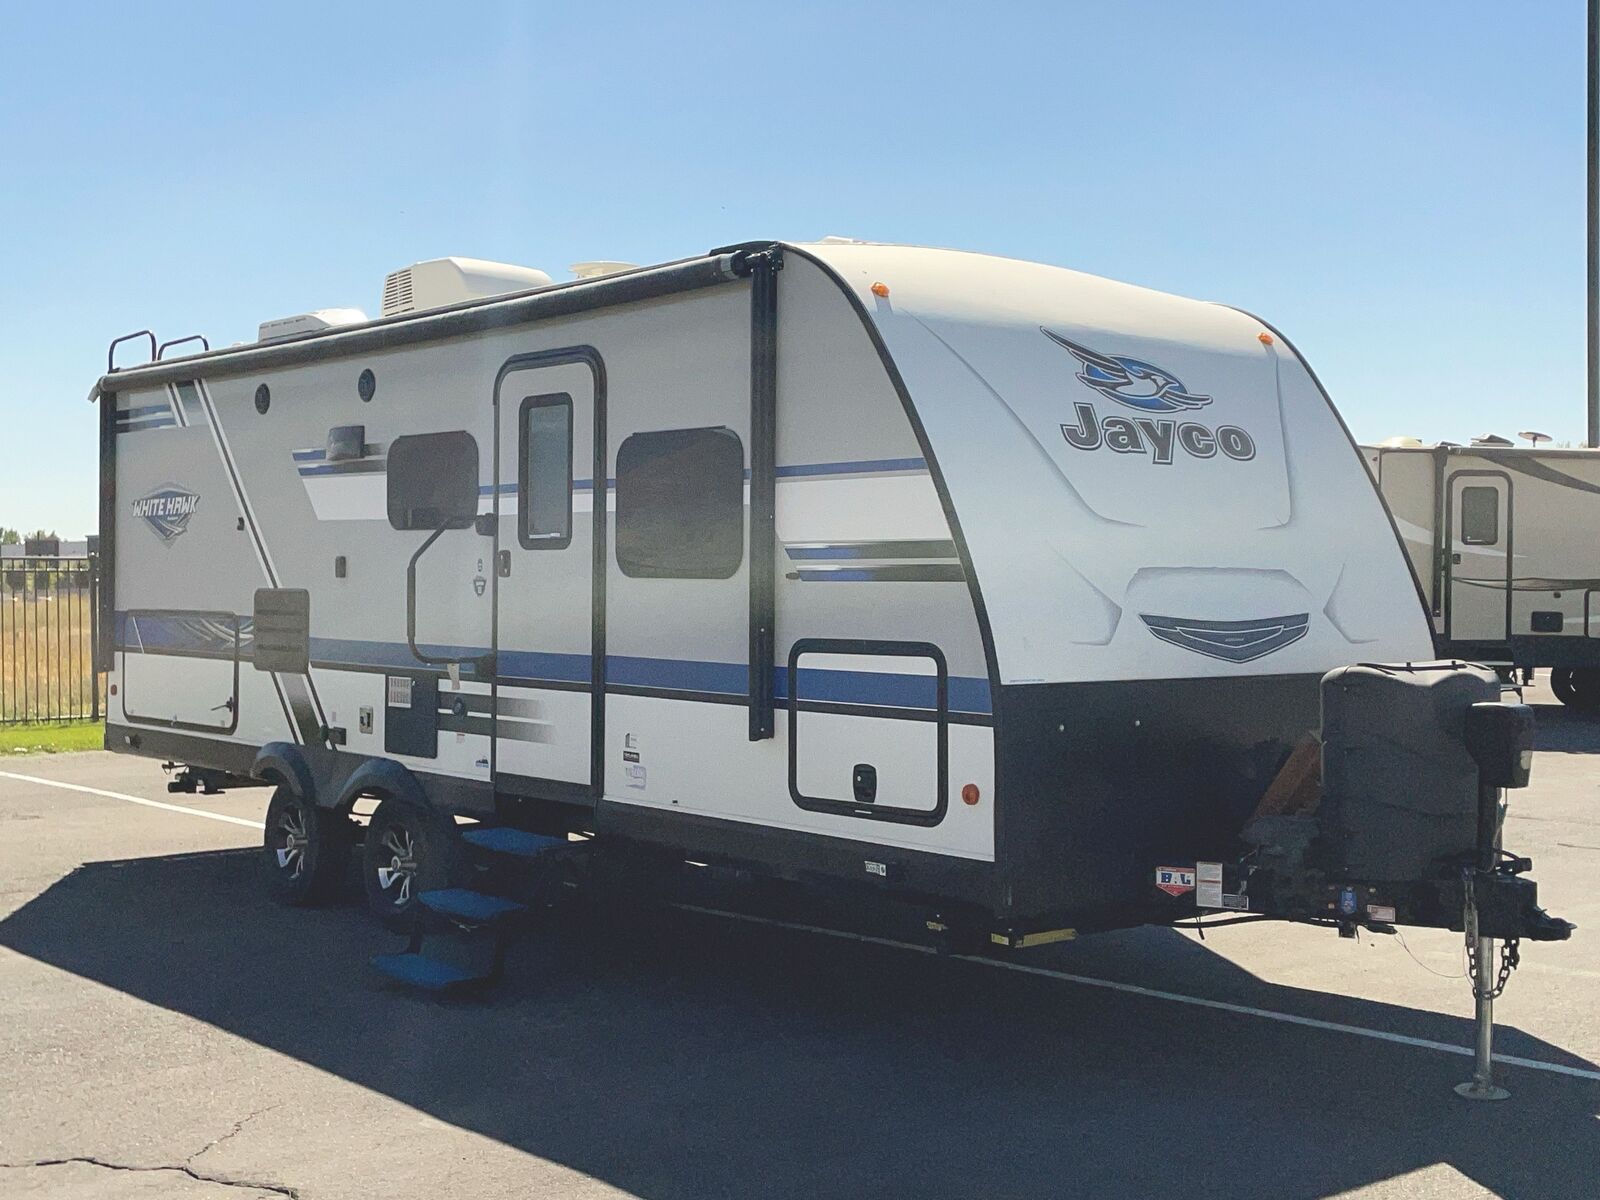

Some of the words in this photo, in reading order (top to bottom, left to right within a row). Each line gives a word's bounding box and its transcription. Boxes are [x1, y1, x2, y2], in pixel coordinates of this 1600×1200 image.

[1060, 402, 1256, 465] Jayco
[132, 498, 165, 517] WHITE
[166, 495, 200, 515] HAWK
